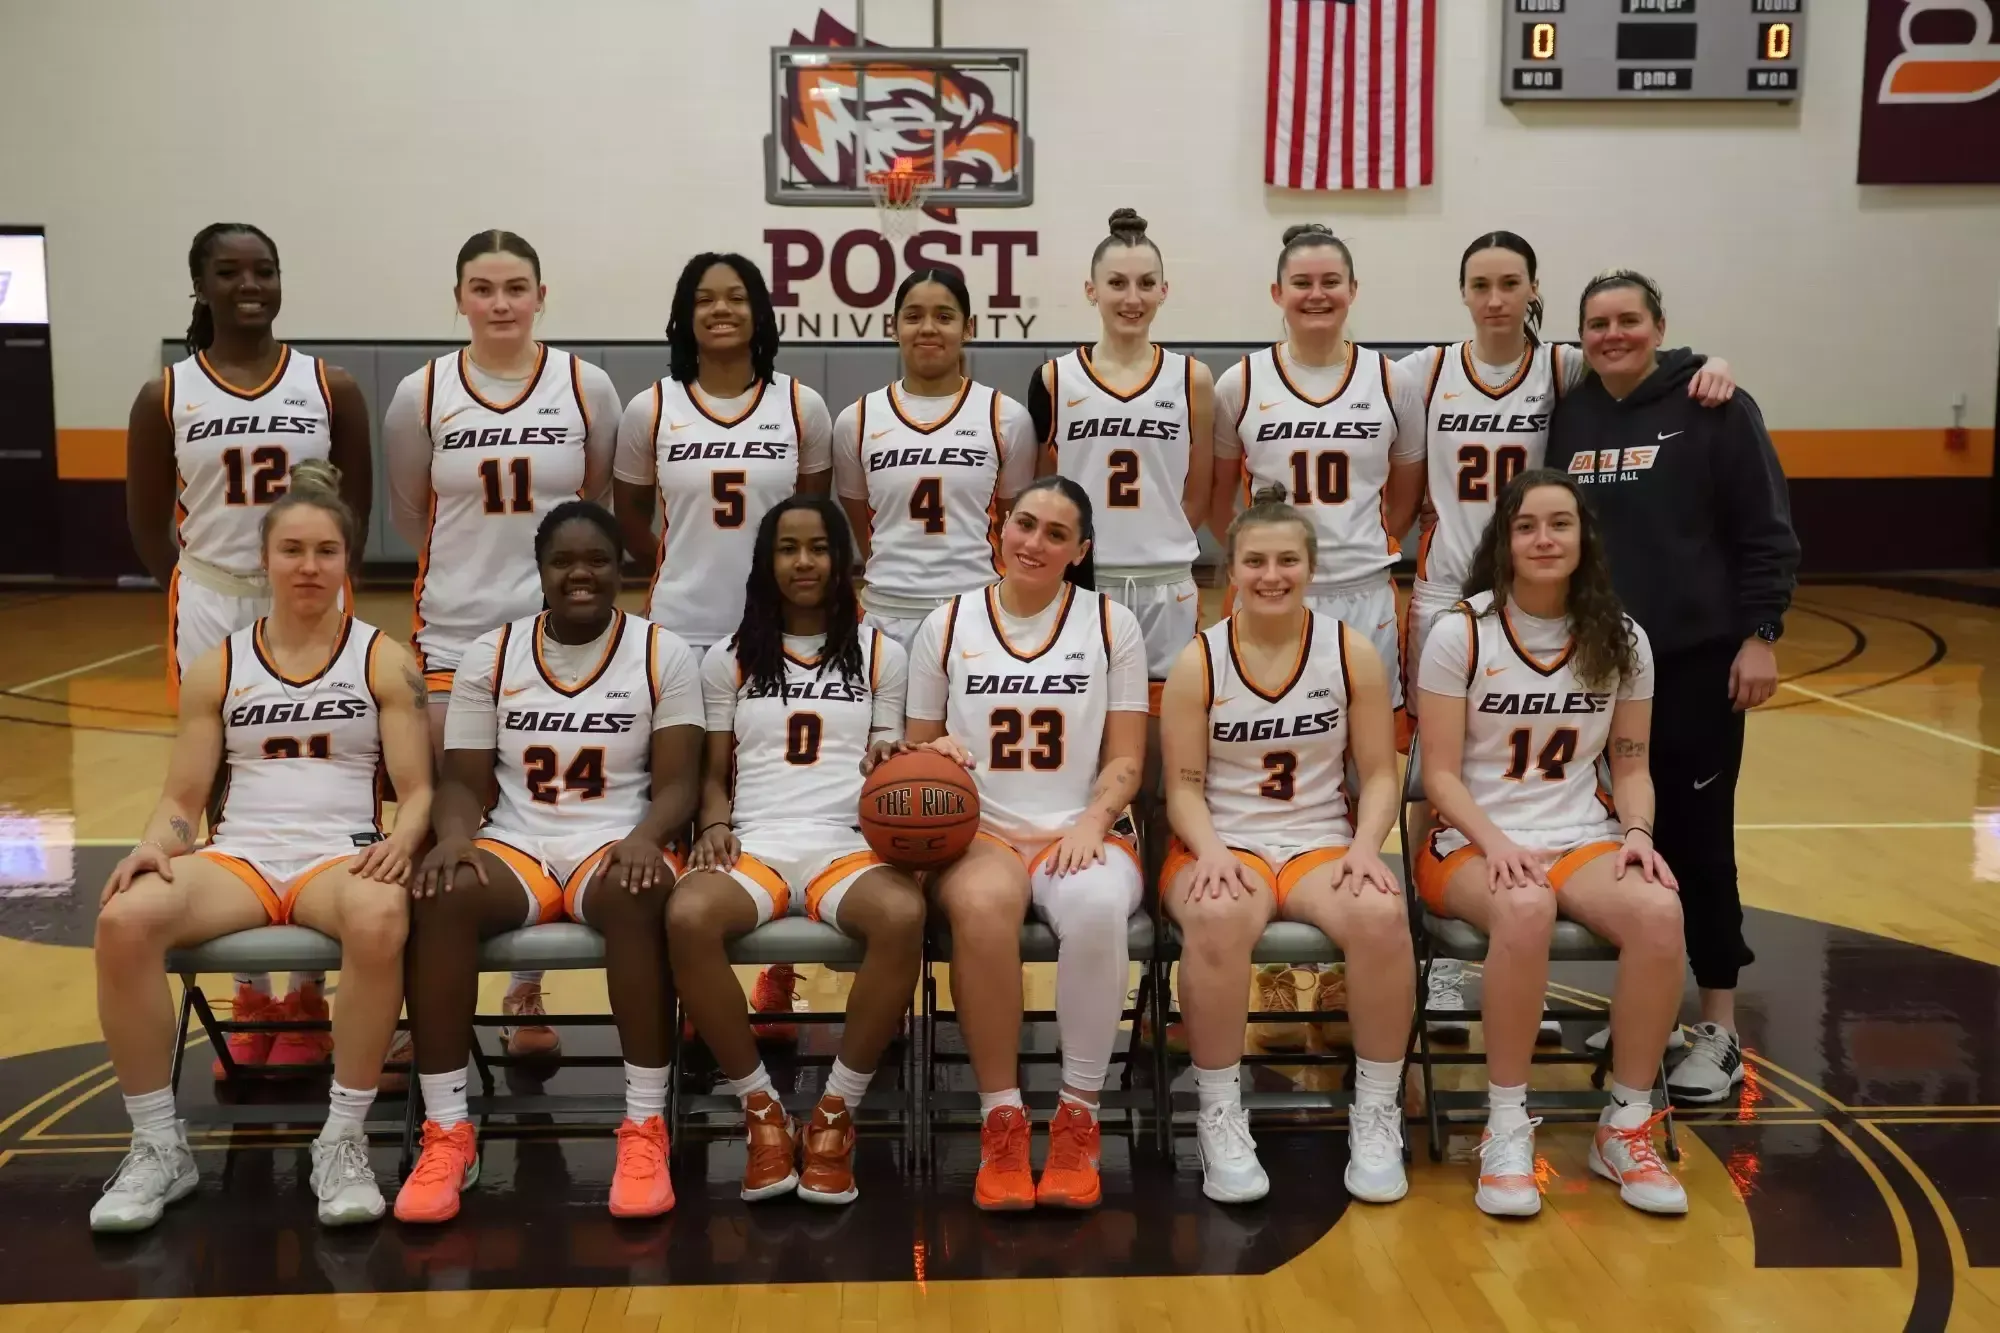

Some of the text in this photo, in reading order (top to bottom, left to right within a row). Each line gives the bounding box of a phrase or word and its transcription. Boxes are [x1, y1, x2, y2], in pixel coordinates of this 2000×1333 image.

[1532, 23, 1554, 58] 0
[1767, 23, 1790, 58] 0
[1522, 71, 1554, 86] won
[1633, 71, 1677, 90] game
[1757, 71, 1789, 86] won
[763, 229, 1039, 308] POST
[778, 312, 1037, 339] NIVEITY
[1155, 400, 1175, 409] CACC
[1350, 402, 1371, 410] CACC
[186, 416, 318, 443] EAGLES
[1067, 417, 1181, 441] EAGLES
[1256, 421, 1382, 442] EAGLES
[1437, 413, 1549, 432] EAGLES
[443, 427, 568, 450] EAGLES
[667, 441, 789, 462] EAGLES
[870, 447, 988, 472] EAGLES
[1457, 443, 1528, 503] 20
[221, 444, 290, 506] 12
[478, 457, 534, 515] 11
[1106, 448, 1140, 509] 2
[1288, 449, 1350, 505] 10
[710, 469, 747, 530] 5
[908, 476, 947, 535] 4
[605, 691, 631, 699] CACC
[965, 674, 1091, 694] EAGLES
[1307, 688, 1330, 699] CACC
[230, 699, 368, 727] EAGLES
[1478, 692, 1611, 715] EAGLES
[505, 711, 637, 733] EAGLES
[1213, 708, 1339, 742] EAGLES
[784, 710, 824, 767] 0
[989, 706, 1066, 772] 23
[1502, 726, 1580, 783] 14
[523, 744, 607, 806] 24
[1258, 750, 1299, 801] 3
[875, 787, 967, 817] THE ROCK
